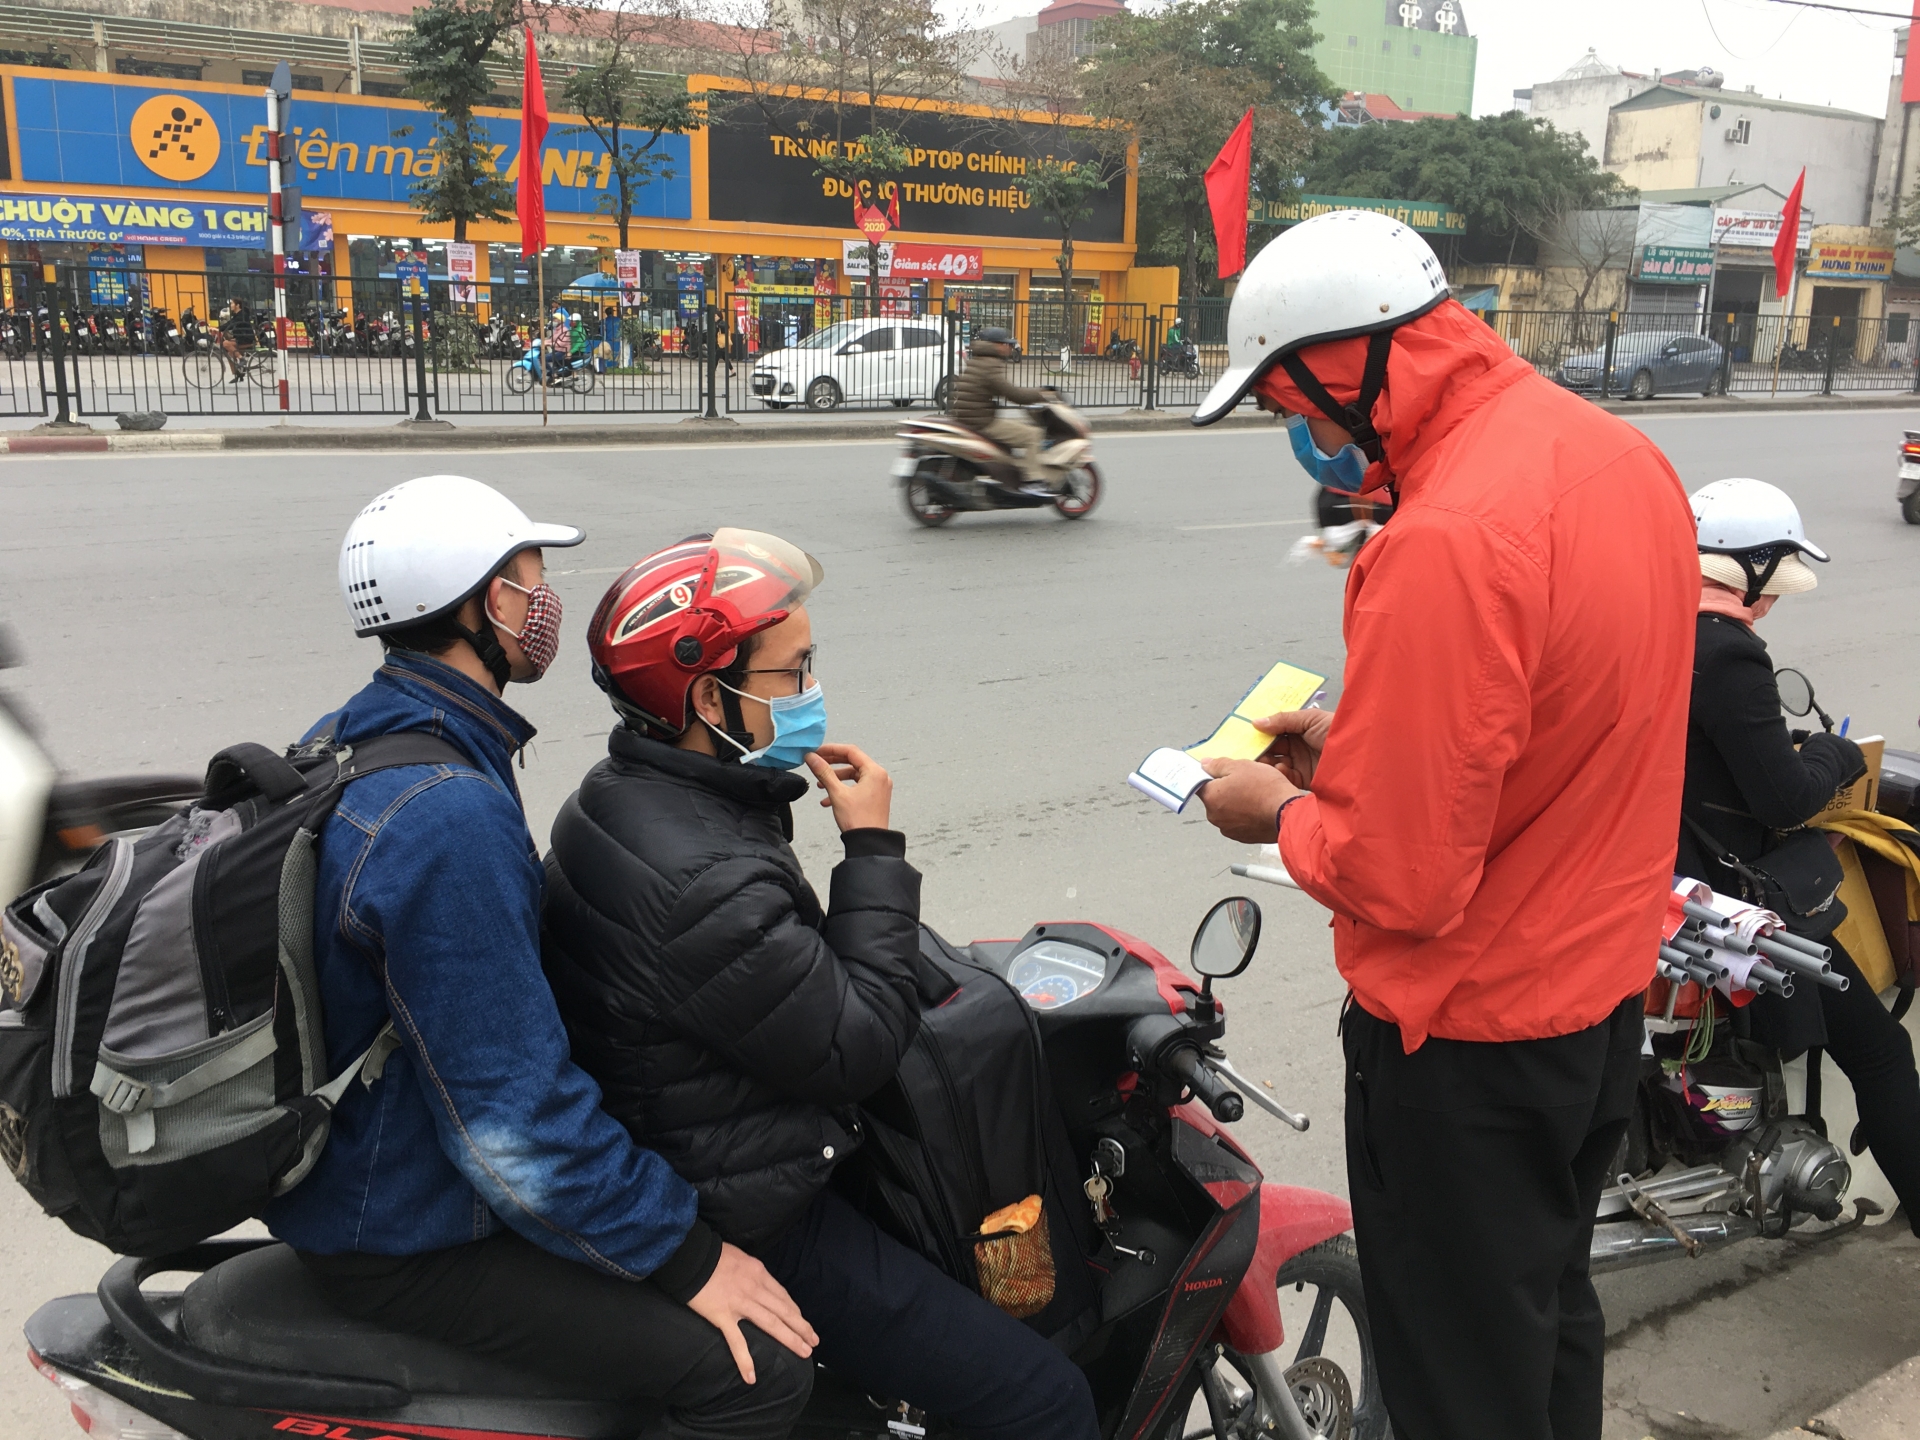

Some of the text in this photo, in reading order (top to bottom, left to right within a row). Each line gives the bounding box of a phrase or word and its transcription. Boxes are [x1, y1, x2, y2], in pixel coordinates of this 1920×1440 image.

[240, 124, 359, 179] Đện
[364, 138, 450, 177] má
[770, 135, 838, 159] TRUNG
[899, 147, 963, 170] APTOP
[967, 150, 1026, 175] CHÍNH
[903, 182, 984, 207] THƯƠNG
[988, 185, 1032, 214] HIỆU
[0, 197, 95, 229] HUỘT
[101, 201, 195, 229] VÀNG
[203, 209, 218, 230] 1
[1412, 209, 1439, 228] NAM
[1445, 211, 1466, 230] VPC
[57, 229, 106, 241] TRƯỚC
[863, 222, 886, 232] 2020
[288, 261, 299, 269] LG
[893, 257, 920, 270] Giảm
[921, 258, 937, 271] sốc
[1642, 258, 1662, 273] SÀN
[1675, 260, 1695, 275] LÂM
[1821, 259, 1886, 274] HƯNG THỊNH
[674, 586, 689, 604] 9
[629, 608, 647, 627] HELMET
[1184, 1277, 1223, 1291] HONDA
[272, 1416, 412, 1440] BL
